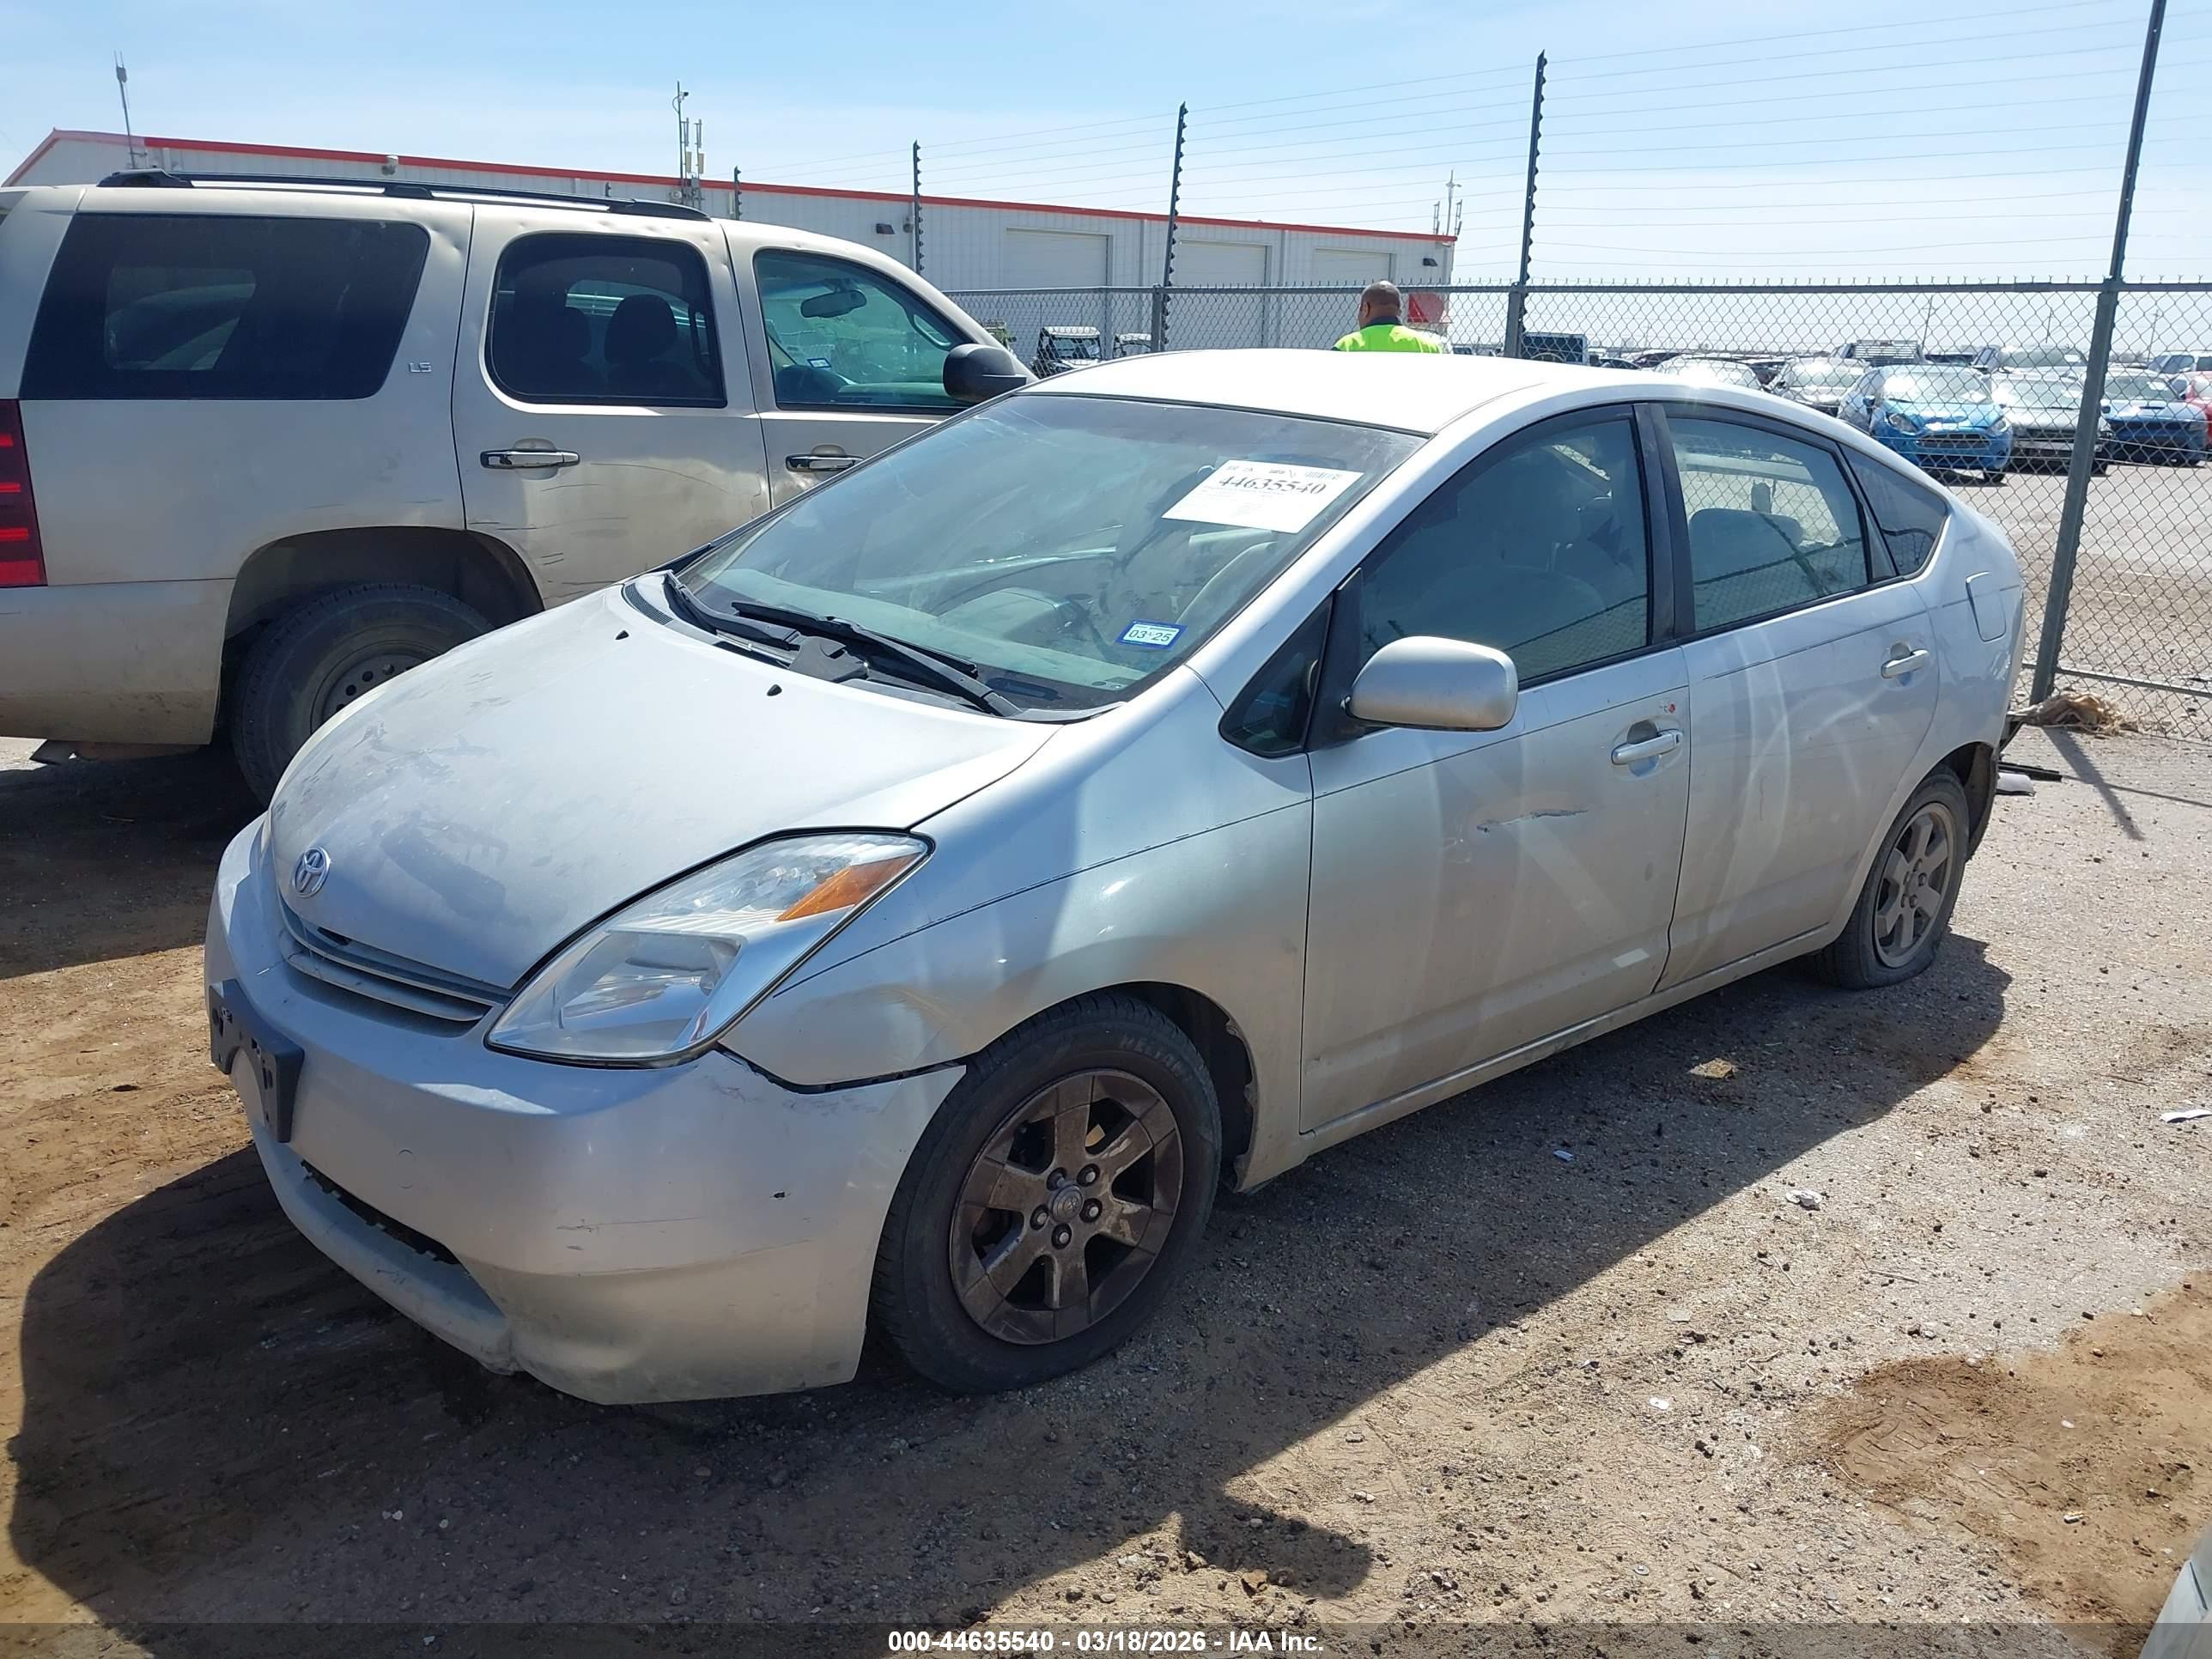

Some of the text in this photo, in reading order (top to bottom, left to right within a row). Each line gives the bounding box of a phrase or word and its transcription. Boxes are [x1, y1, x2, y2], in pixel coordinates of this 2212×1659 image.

[408, 362, 432, 373] LS
[1218, 475, 1328, 495] 44635540
[1127, 629, 1148, 640] 03
[1151, 632, 1173, 642] 25
